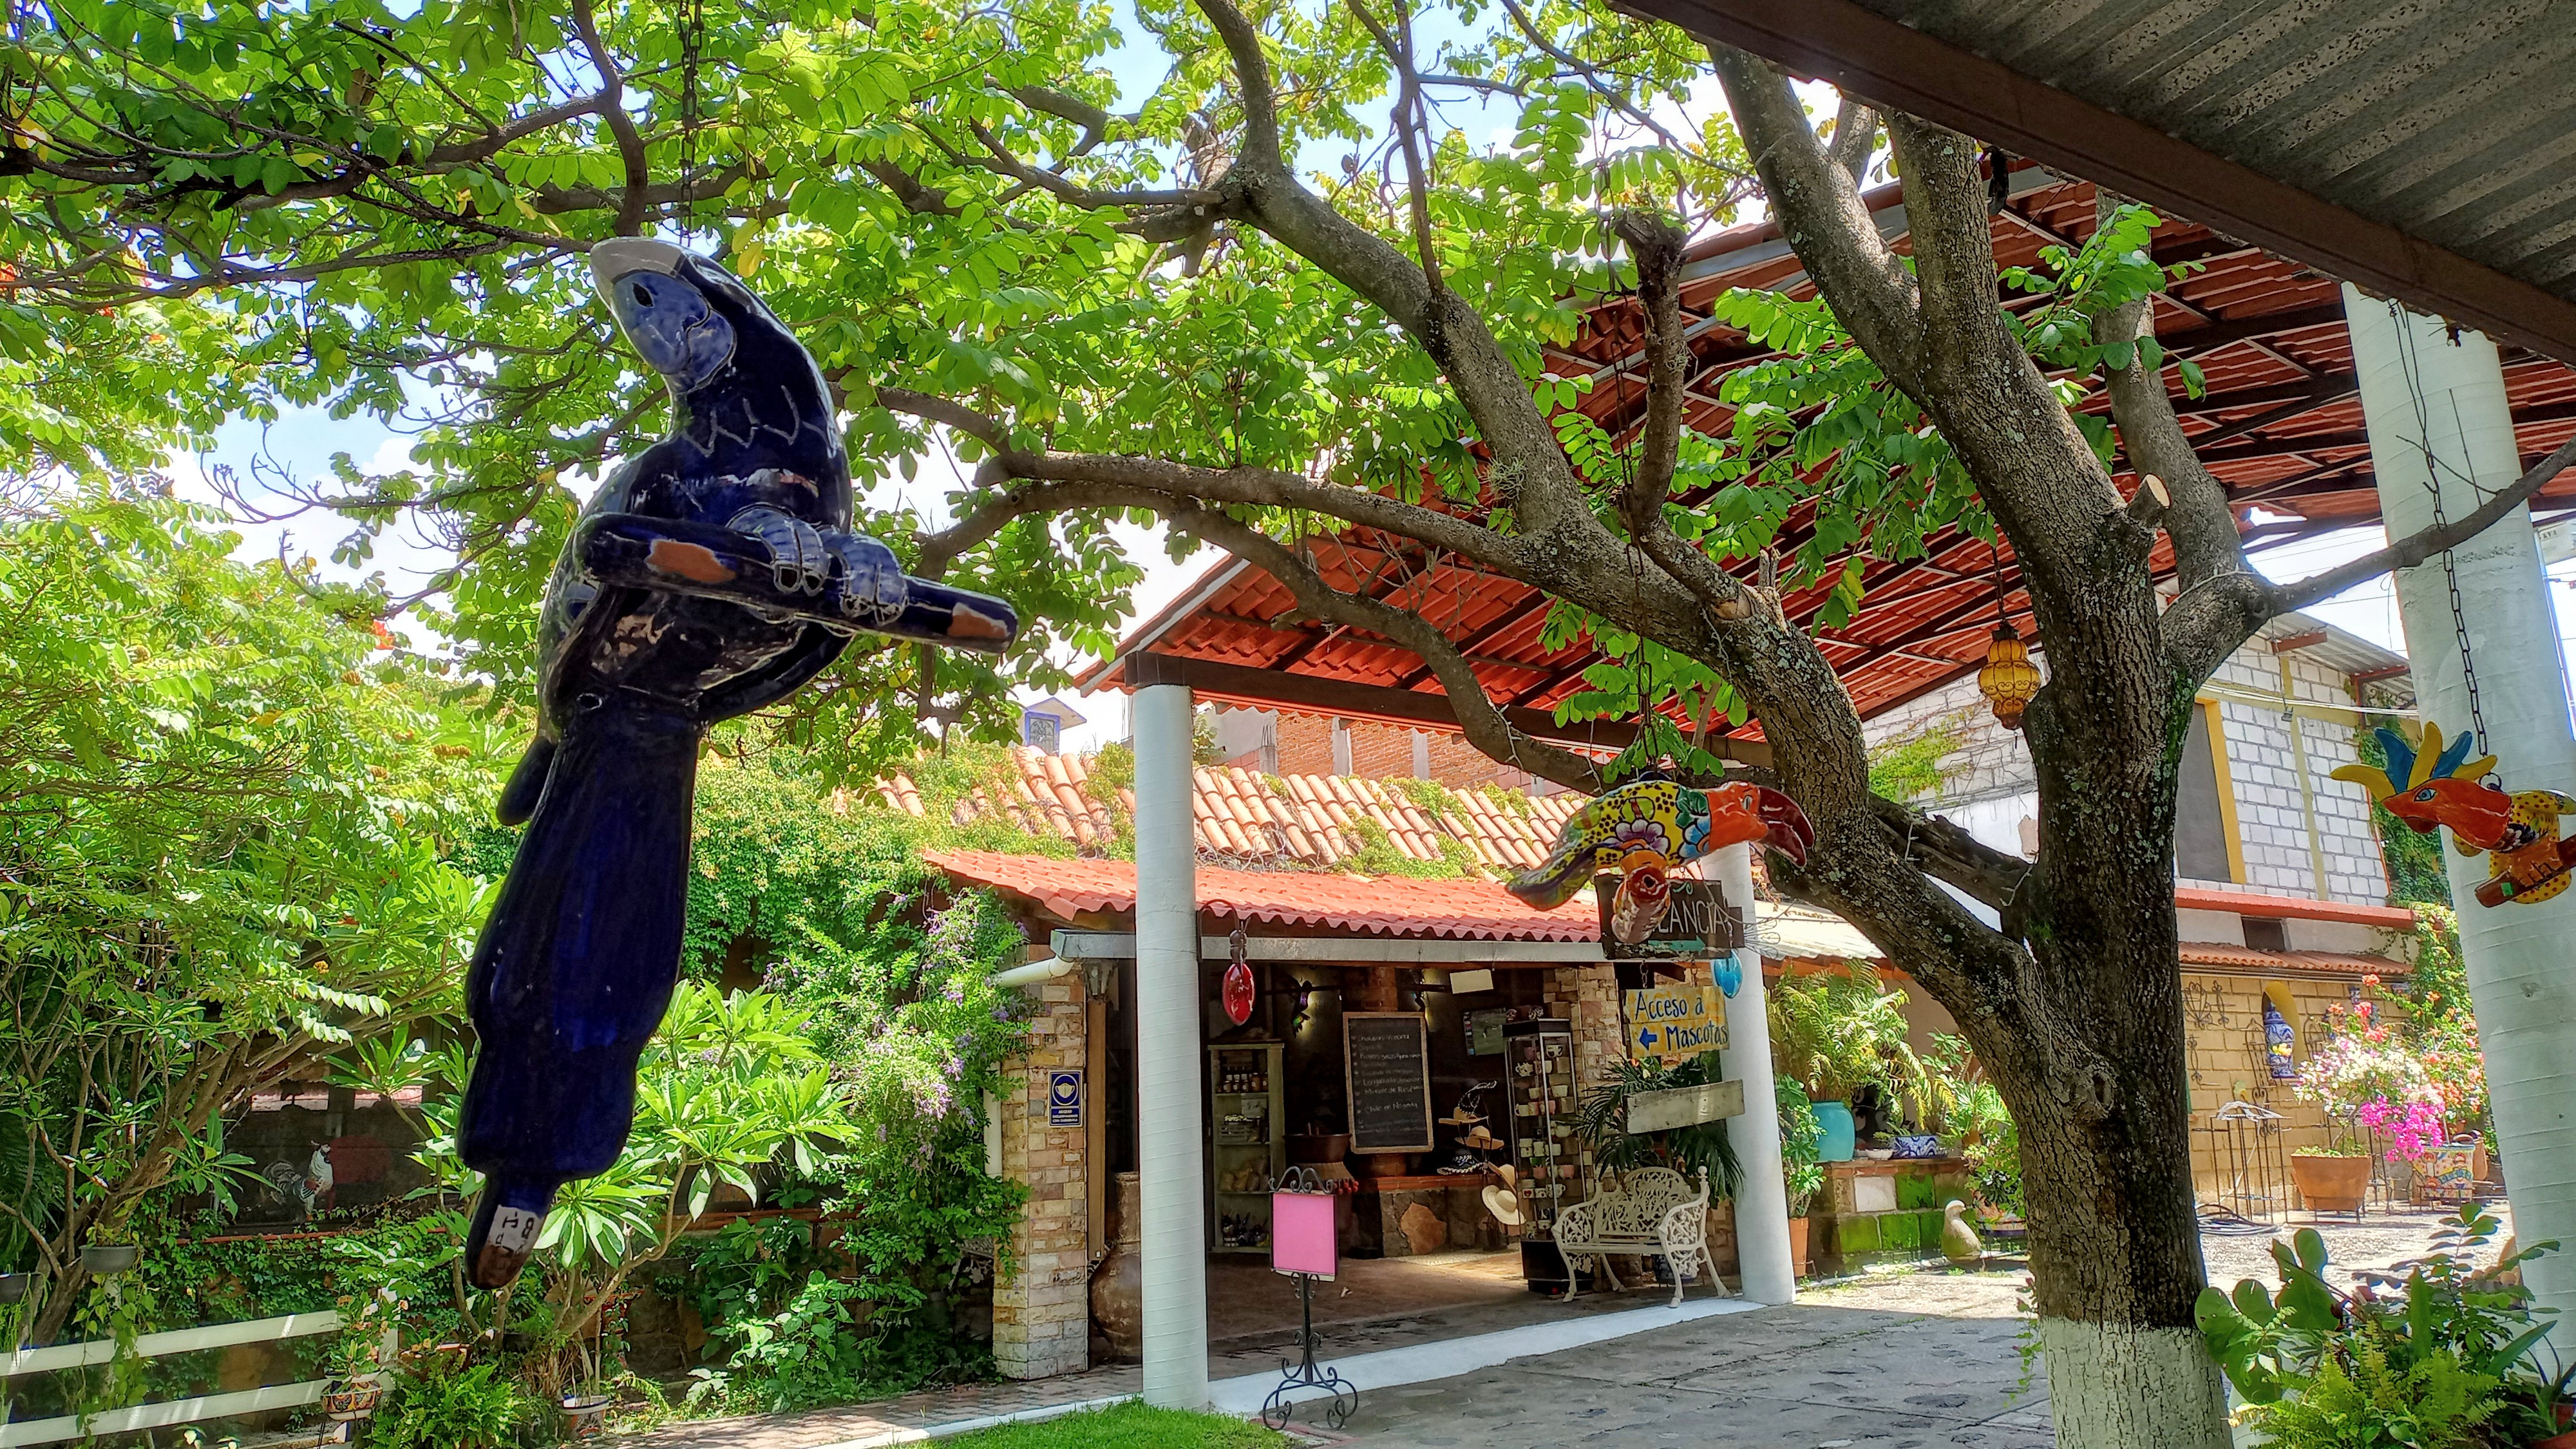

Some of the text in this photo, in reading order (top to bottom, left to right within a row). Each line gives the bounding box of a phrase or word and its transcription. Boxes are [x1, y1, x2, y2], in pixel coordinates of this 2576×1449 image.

[1653, 900, 1727, 934] LANCIA
[1634, 990, 1704, 1021] Acceso a
[1665, 1020, 1728, 1051] Mascotas
